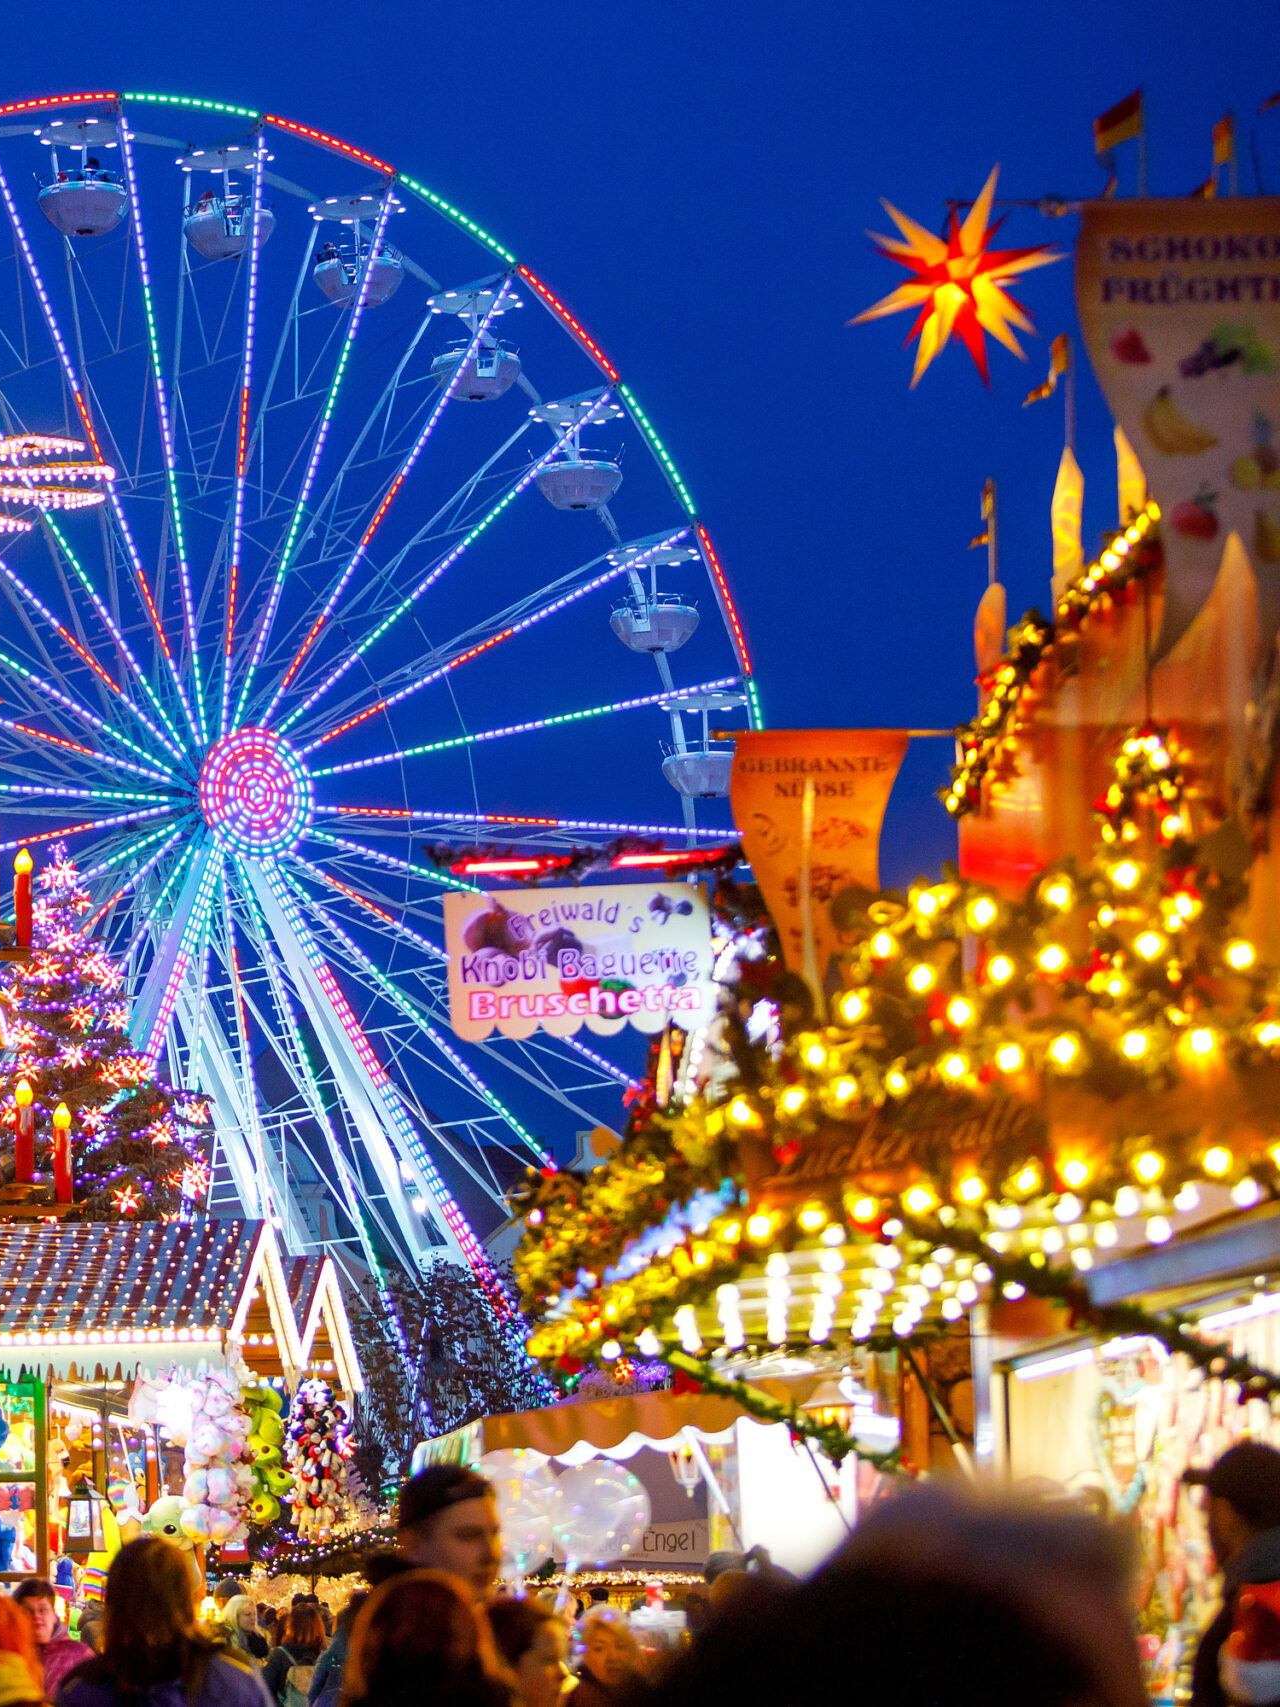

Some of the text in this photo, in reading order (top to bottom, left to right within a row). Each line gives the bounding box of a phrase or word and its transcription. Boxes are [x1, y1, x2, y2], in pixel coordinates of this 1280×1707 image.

[739, 756, 889, 773] GEBRANNTE
[460, 948, 699, 984] Knobi Baguette
[469, 983, 702, 1021] Bruschetta
[643, 1529, 695, 1552] Engel
